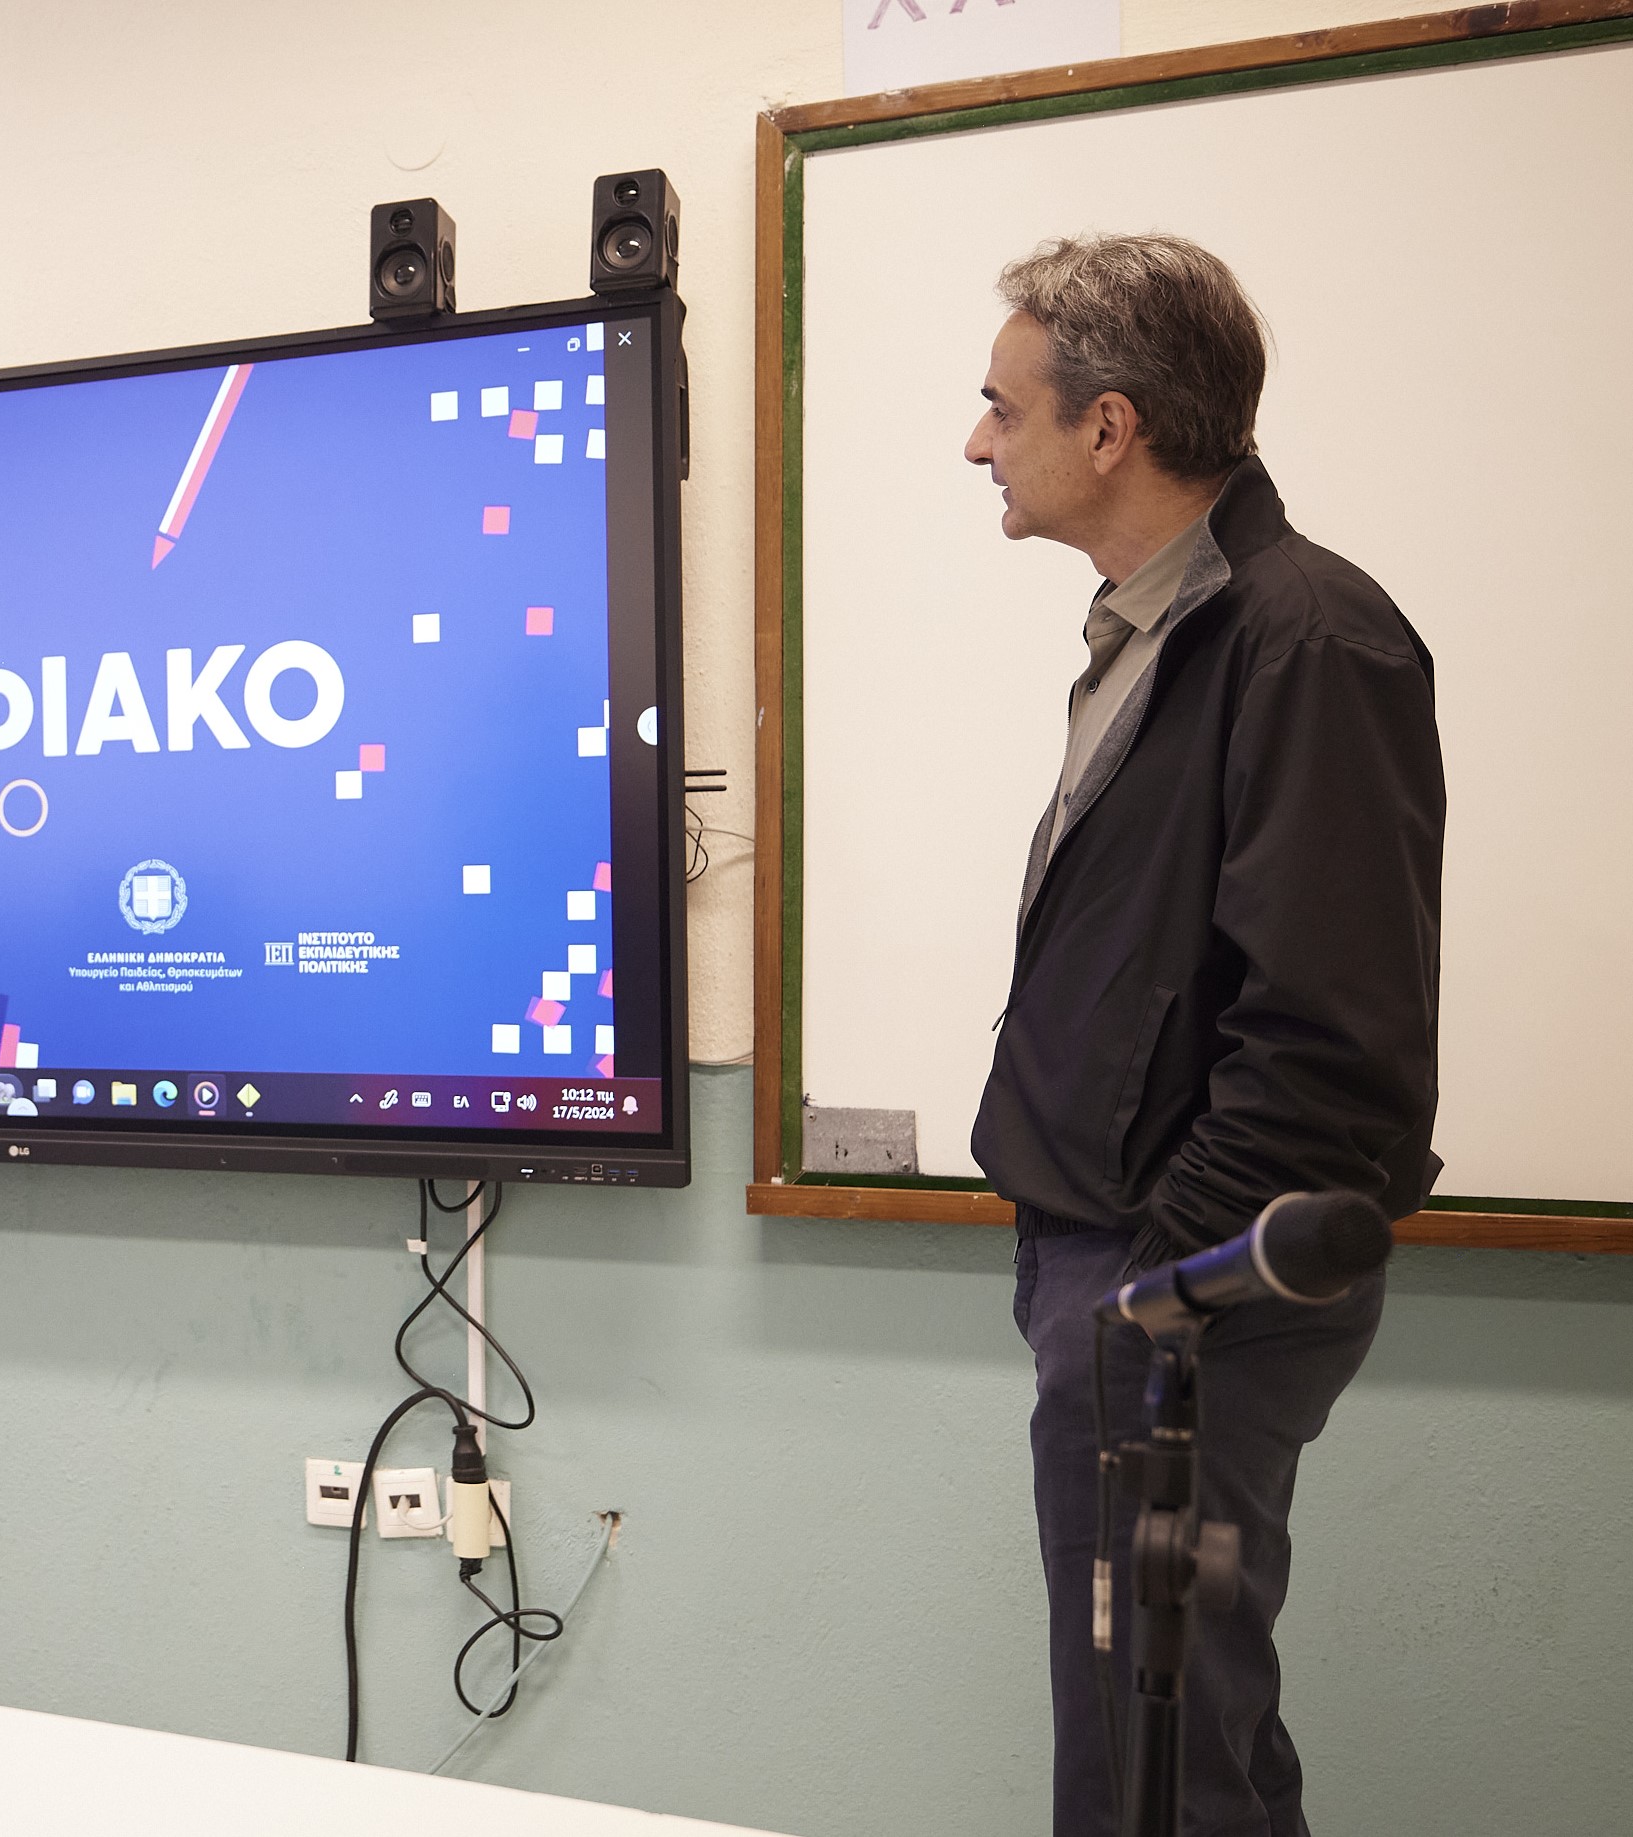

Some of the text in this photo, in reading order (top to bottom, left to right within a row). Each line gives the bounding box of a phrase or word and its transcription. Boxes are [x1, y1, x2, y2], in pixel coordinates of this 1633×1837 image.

[298, 931, 375, 945] ΙΝΣΤΙΤΟΥΤΟ
[87, 951, 226, 964] ΕΛΛΗΝΙΚΗ ΔΗΜΟΚΡΑΤΙΑ
[298, 946, 400, 959] ΕΚΠΑΙΔΕΥΤΙΚΗΣ
[68, 966, 119, 979] Υπουργείο
[167, 966, 243, 979] Θρησκευμάτων
[298, 960, 369, 974] ΠΟΛΙΤΙΚΗΣ
[119, 980, 194, 994] και Αθλητισμού
[453, 1095, 470, 1108] ΕΛ
[561, 1088, 615, 1104] 10:12 πμ
[552, 1106, 615, 1120] 17/5/2024
